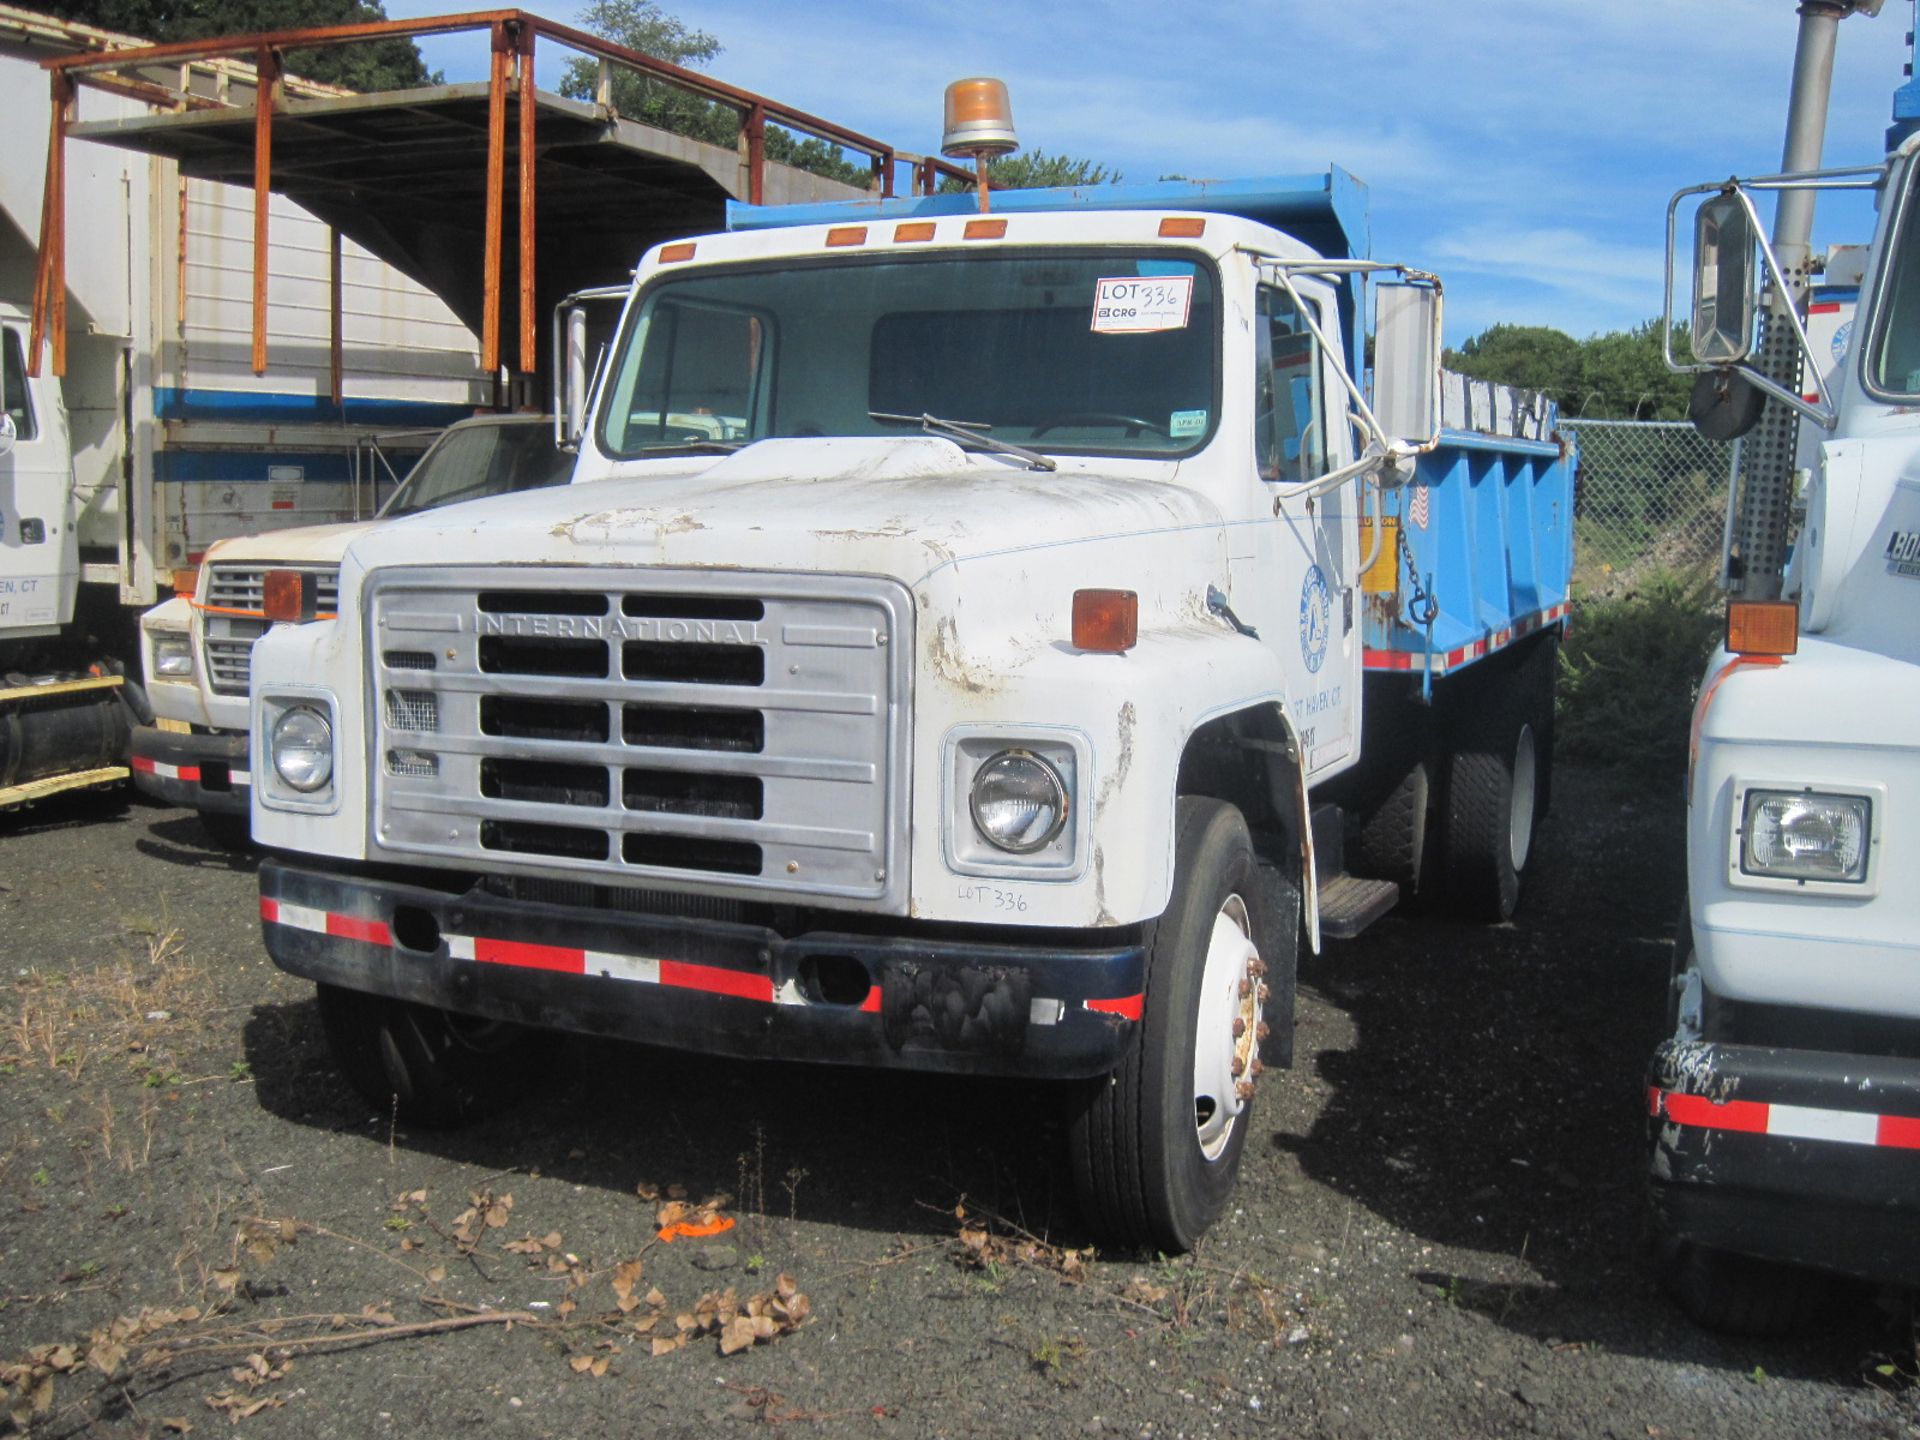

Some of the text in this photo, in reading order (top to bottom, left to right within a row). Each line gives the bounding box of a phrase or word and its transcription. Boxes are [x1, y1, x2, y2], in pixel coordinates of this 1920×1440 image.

[1102, 284, 1177, 308] LOT 336
[1112, 308, 1137, 318] CRG
[21, 580, 38, 593] CT
[474, 614, 768, 645] INTERNATIONAL
[957, 885, 1027, 912] LOT 336
